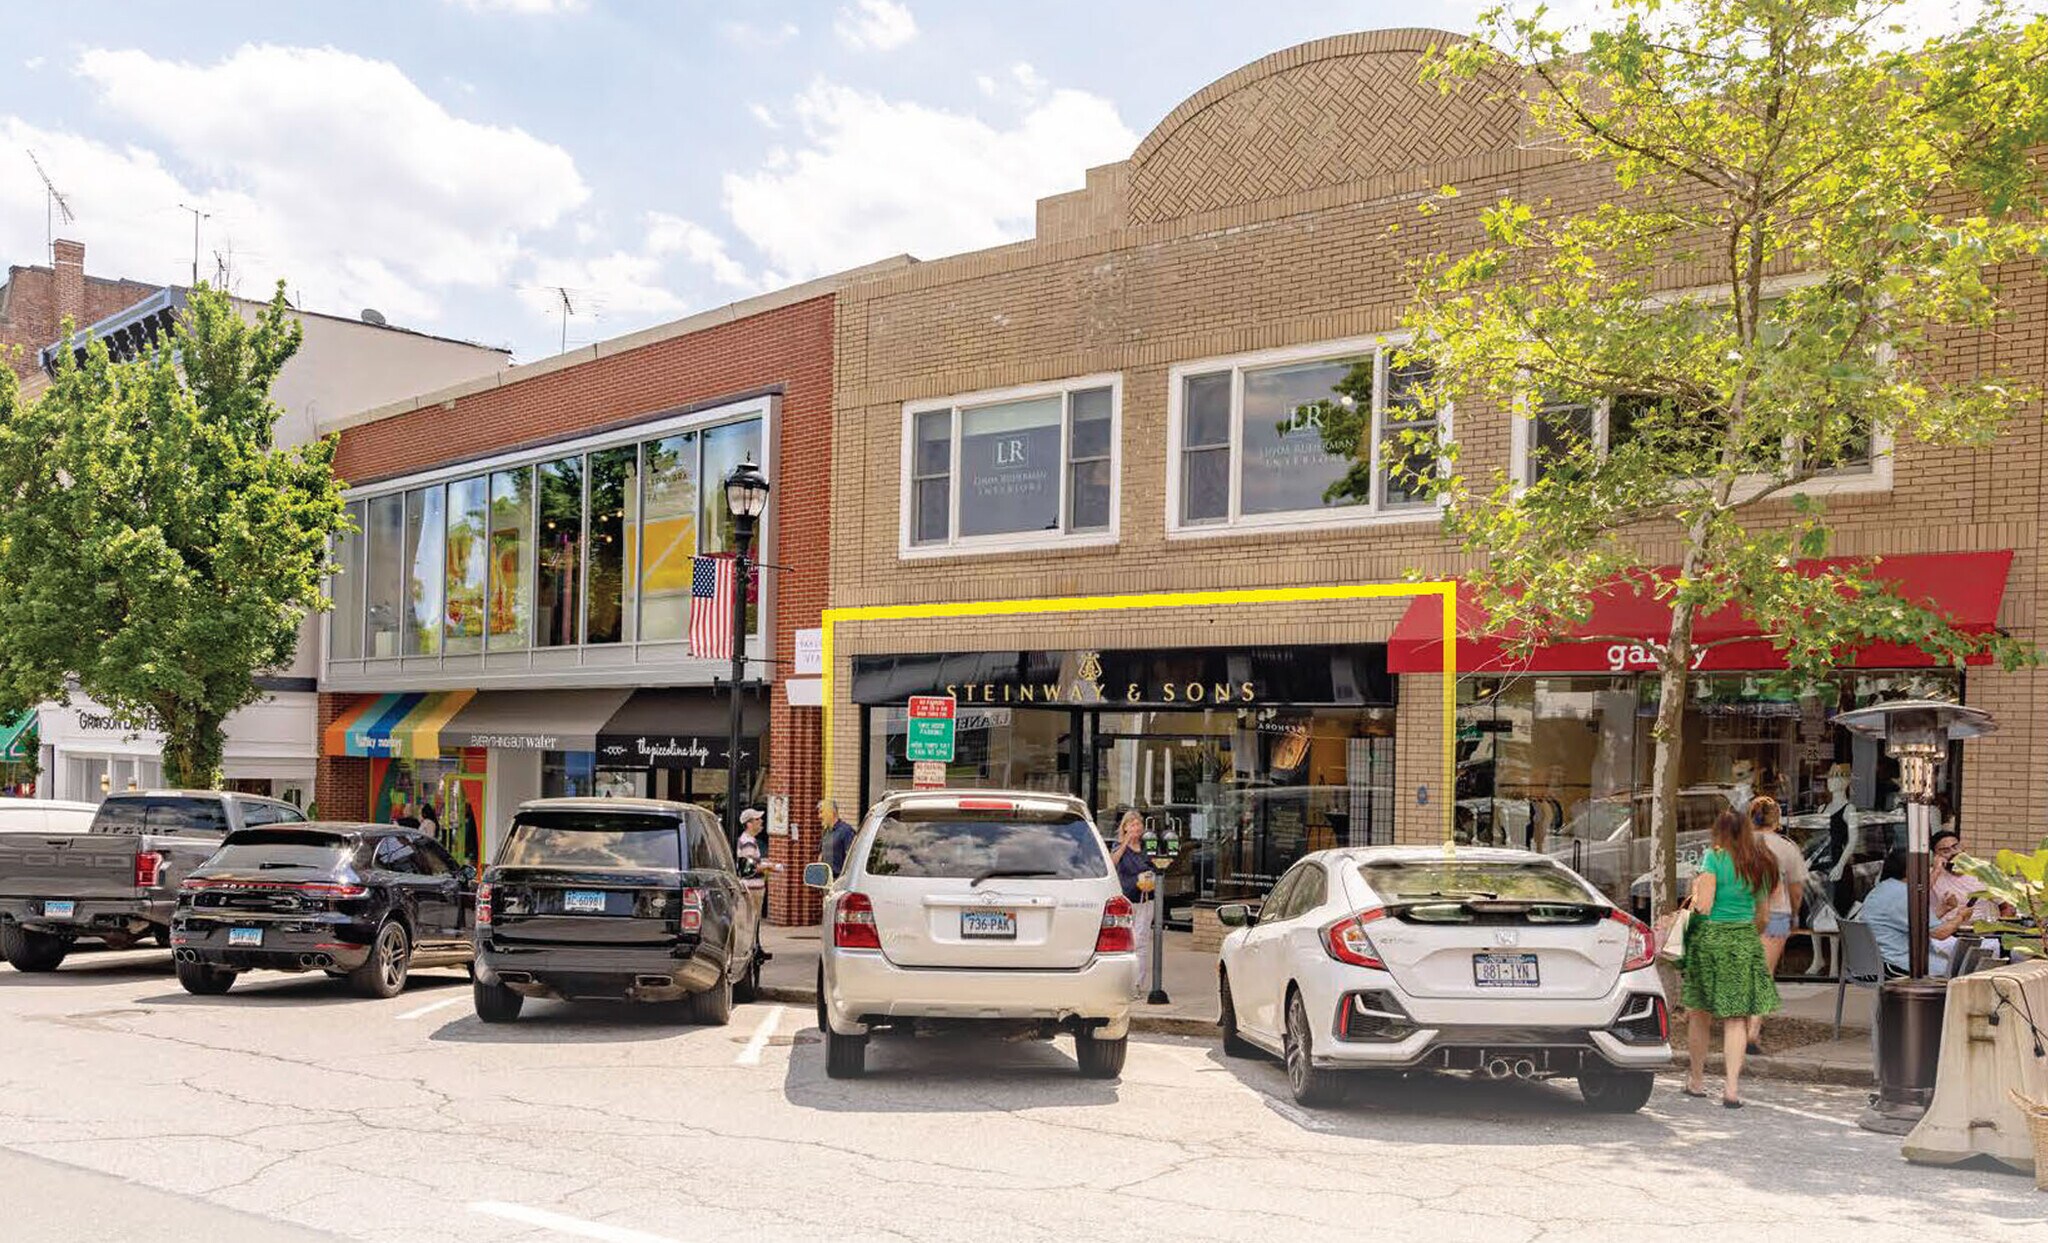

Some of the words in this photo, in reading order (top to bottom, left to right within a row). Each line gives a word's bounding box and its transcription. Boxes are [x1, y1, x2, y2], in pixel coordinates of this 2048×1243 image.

[1289, 404, 1325, 431] LR
[996, 440, 1024, 464] LR
[1607, 637, 1708, 671] gaby
[946, 682, 1104, 702] STEINWAY
[1126, 683, 1142, 702] &
[1163, 682, 1256, 703] SONS
